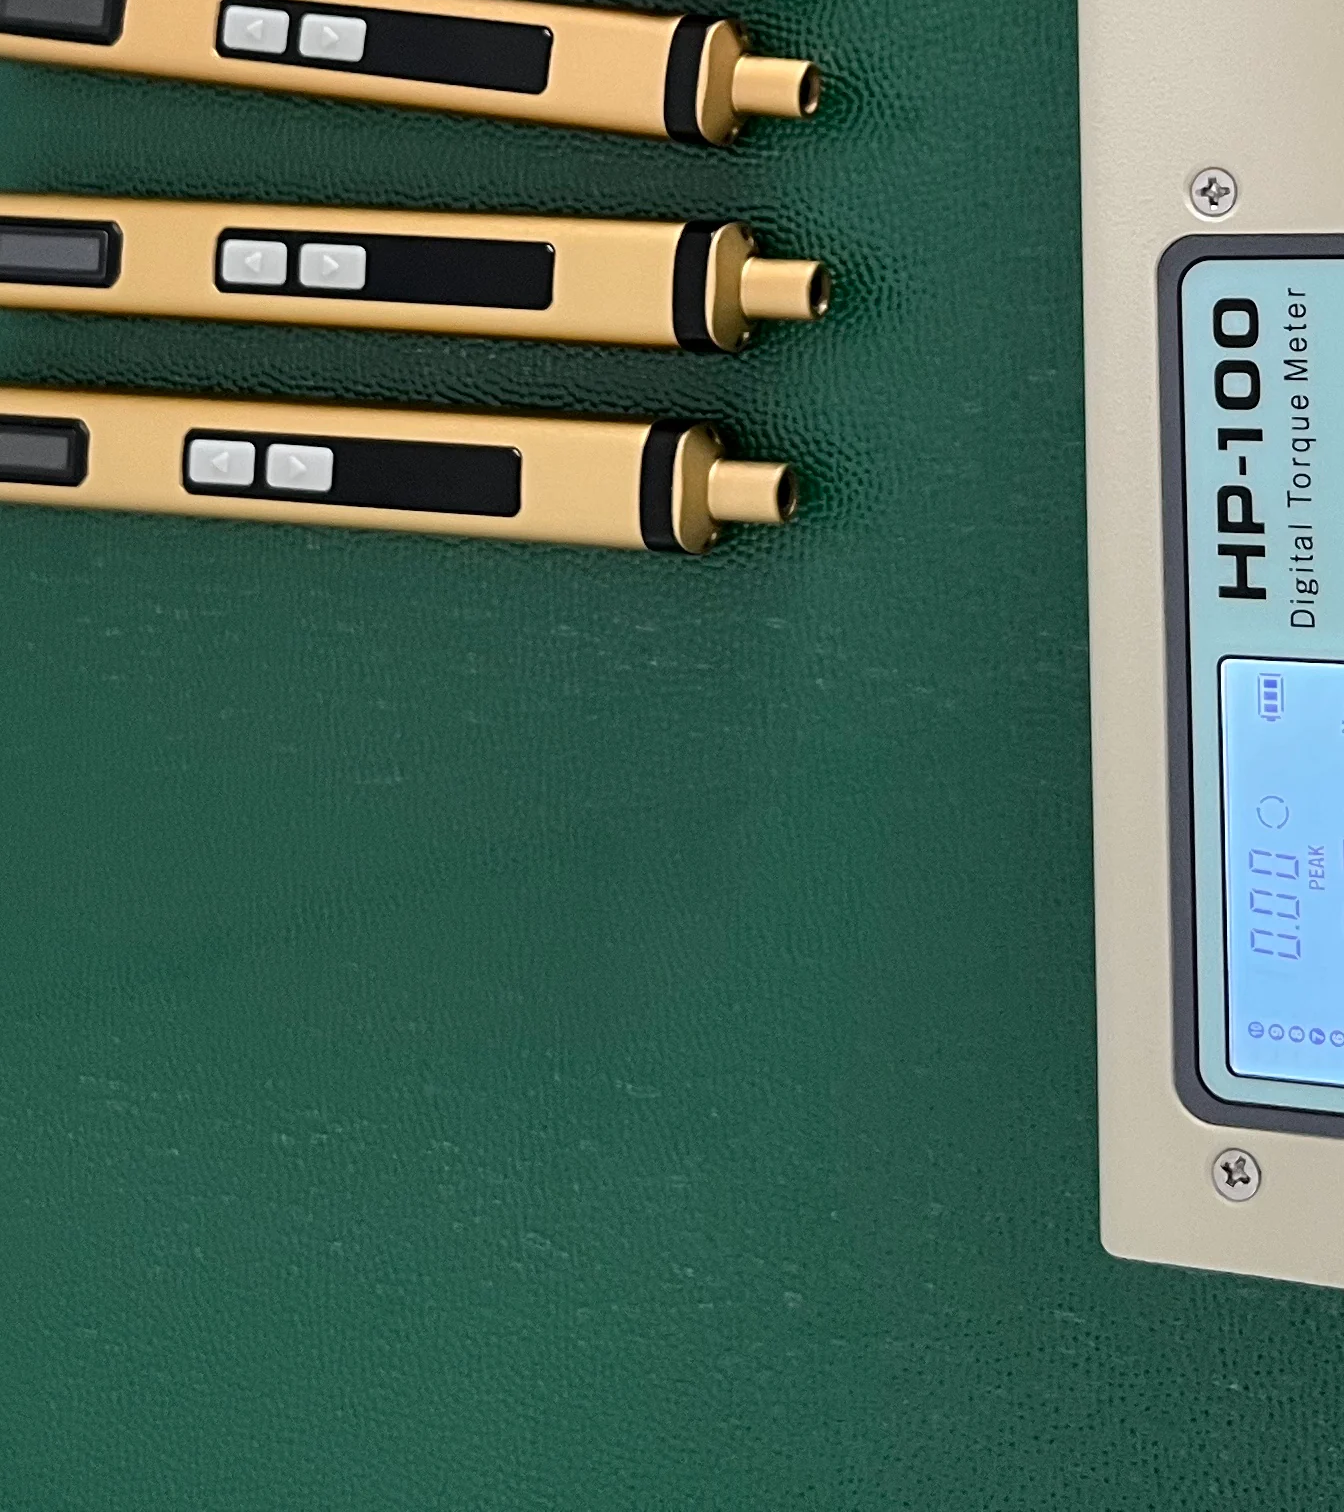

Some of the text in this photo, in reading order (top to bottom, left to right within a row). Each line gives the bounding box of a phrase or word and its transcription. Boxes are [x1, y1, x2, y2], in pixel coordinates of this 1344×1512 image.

[1213, 298, 1266, 600] HP-100
[1283, 287, 1318, 628] Digital Torque Meter
[1248, 849, 1301, 960] 0.00
[1308, 845, 1325, 890] PEAK
